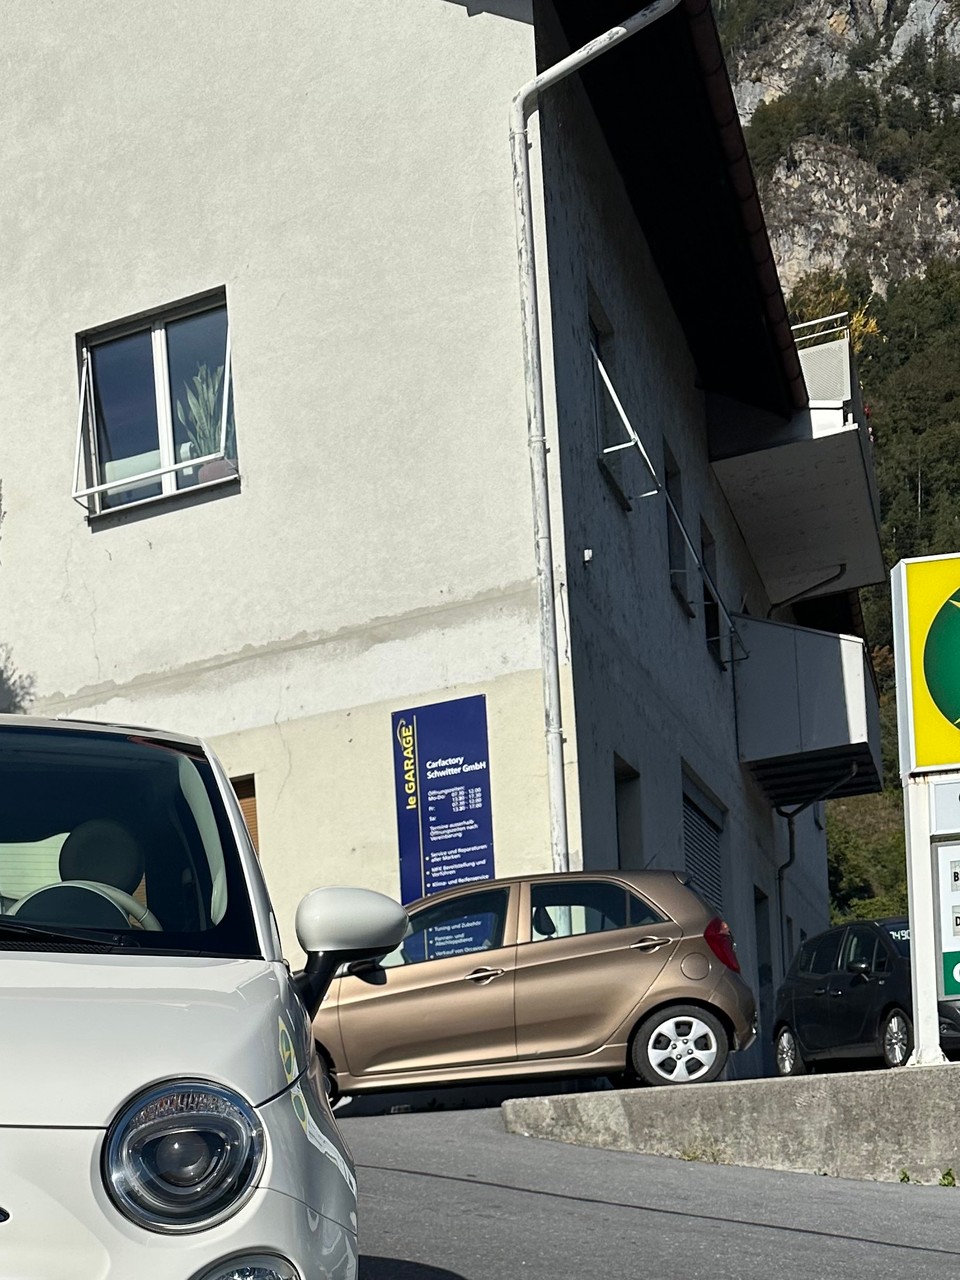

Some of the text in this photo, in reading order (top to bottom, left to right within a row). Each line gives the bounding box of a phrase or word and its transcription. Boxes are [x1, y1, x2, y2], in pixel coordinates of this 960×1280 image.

[402, 725, 417, 810] le GARAGE
[426, 757, 464, 769] Carfactory
[426, 761, 487, 780] Schwitter GmbH
[431, 850, 447, 858] Service
[458, 845, 488, 853] Reparaturen
